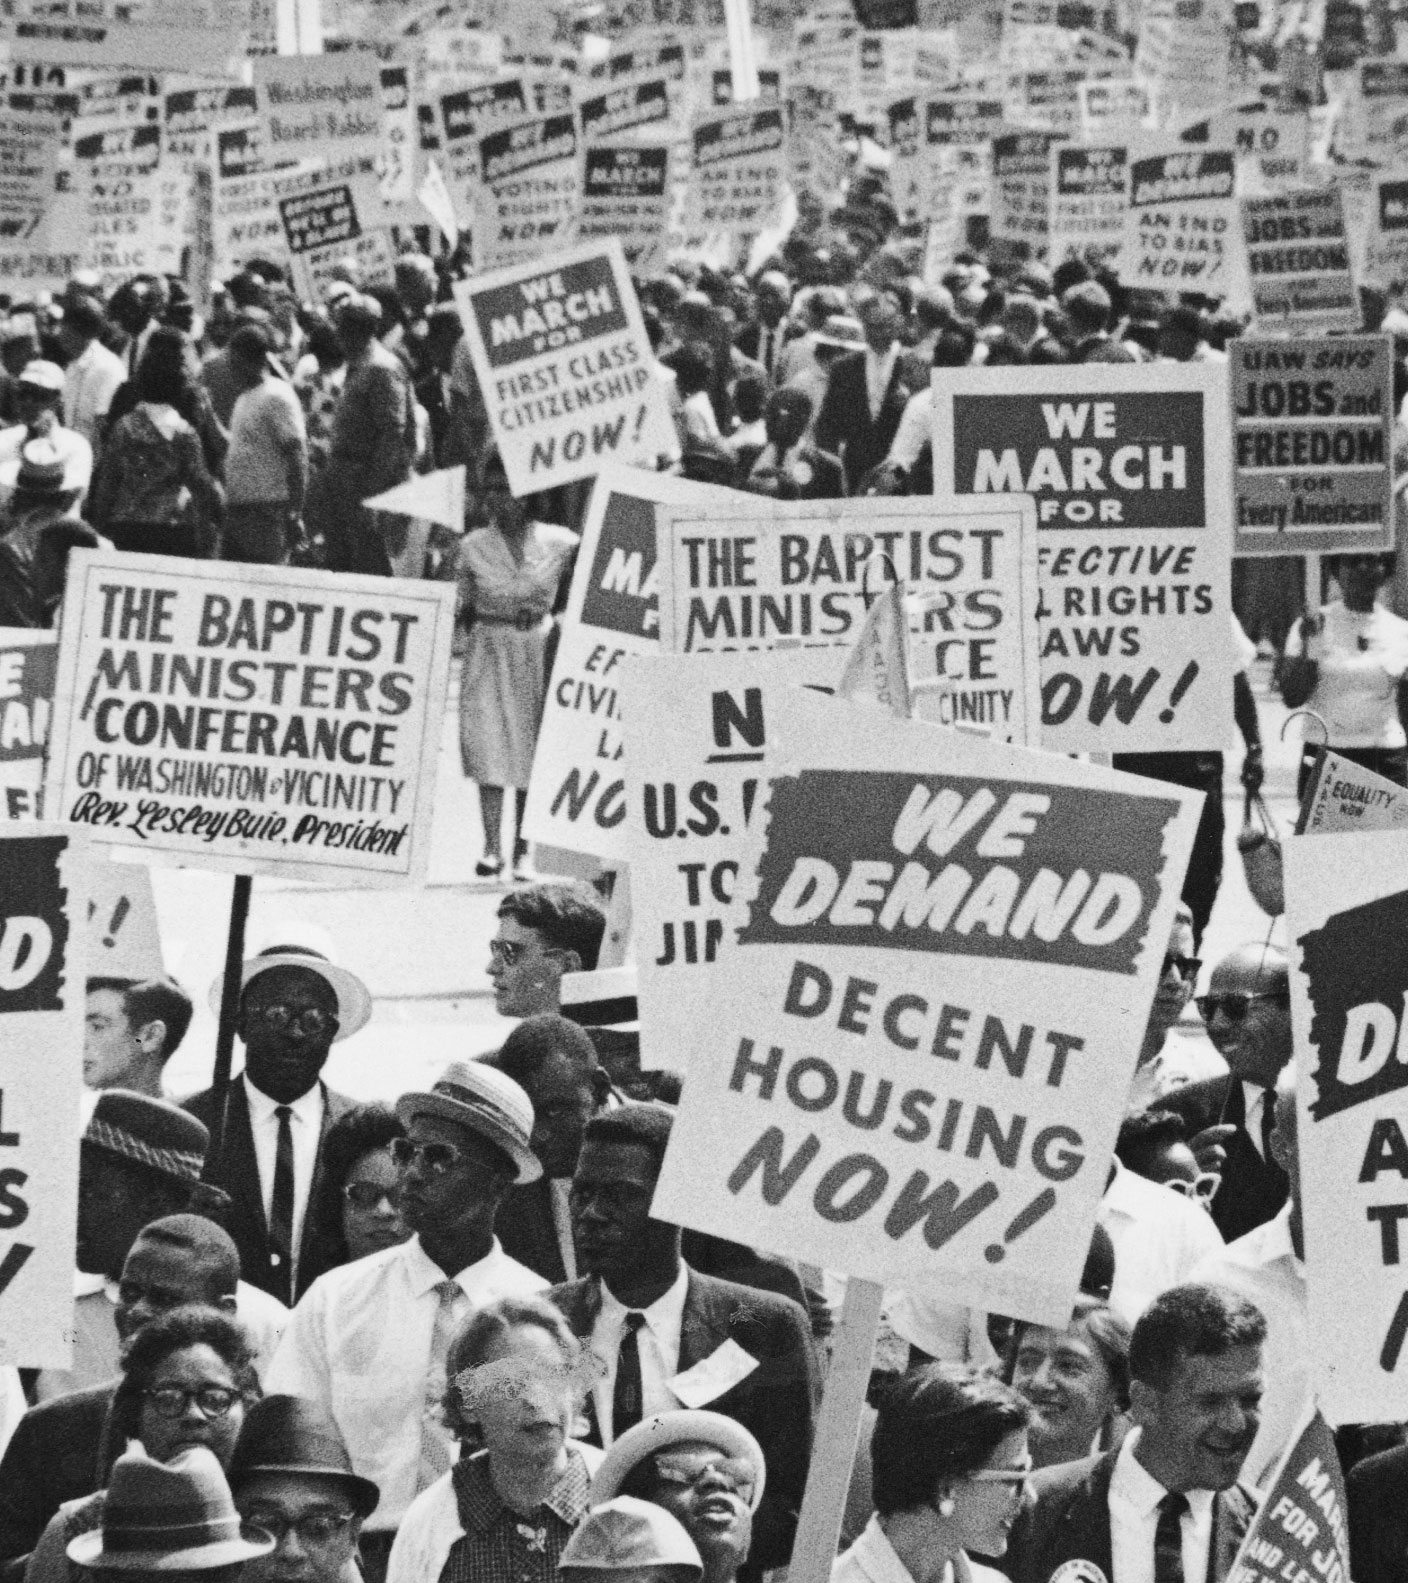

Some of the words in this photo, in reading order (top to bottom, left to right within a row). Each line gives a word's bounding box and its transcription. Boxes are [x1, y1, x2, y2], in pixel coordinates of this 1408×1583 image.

[491, 284, 614, 348] MARCH
[519, 273, 567, 303] WE
[532, 325, 583, 351] FOR
[1312, 348, 1375, 371] SAYS
[495, 362, 560, 402] FIRST
[568, 340, 641, 380] CLASS
[498, 366, 650, 431] CITIZENSHIP
[1236, 380, 1335, 417] JOBS
[1339, 386, 1383, 416] and
[529, 403, 648, 473] NOW!
[1040, 400, 1117, 440] WE
[1236, 428, 1385, 468] FREEDOM
[972, 445, 1188, 493] MARCH
[1039, 498, 1125, 523] FOR
[681, 535, 758, 589] THE
[779, 528, 1006, 588] BAPTIST
[1038, 544, 1197, 578] FECTIVE
[98, 583, 178, 644] THE
[197, 592, 419, 665] BAPTIST
[1062, 584, 1214, 618] RIGHTS
[1039, 626, 1142, 659] AWS
[79, 647, 415, 721] MINISTERS
[555, 676, 624, 722] CIVI
[1040, 659, 1200, 728] OW!
[93, 696, 400, 767] CONFERANCE
[76, 750, 109, 789] OF
[115, 754, 269, 805] WASHINGTON
[283, 767, 406, 815] VICINITY
[642, 779, 731, 839] U.S.
[1332, 779, 1398, 809] EQUALITY
[69, 790, 127, 830] Rev.
[292, 813, 411, 857] President
[891, 782, 1052, 859] WE
[769, 856, 1144, 947] DEMAND
[782, 959, 1086, 1089] DECENT
[727, 1036, 1086, 1182] HOUSING
[726, 1123, 1058, 1265] NOW!
[1268, 1495, 1320, 1549] FOR
[1247, 1536, 1285, 1569] AND
